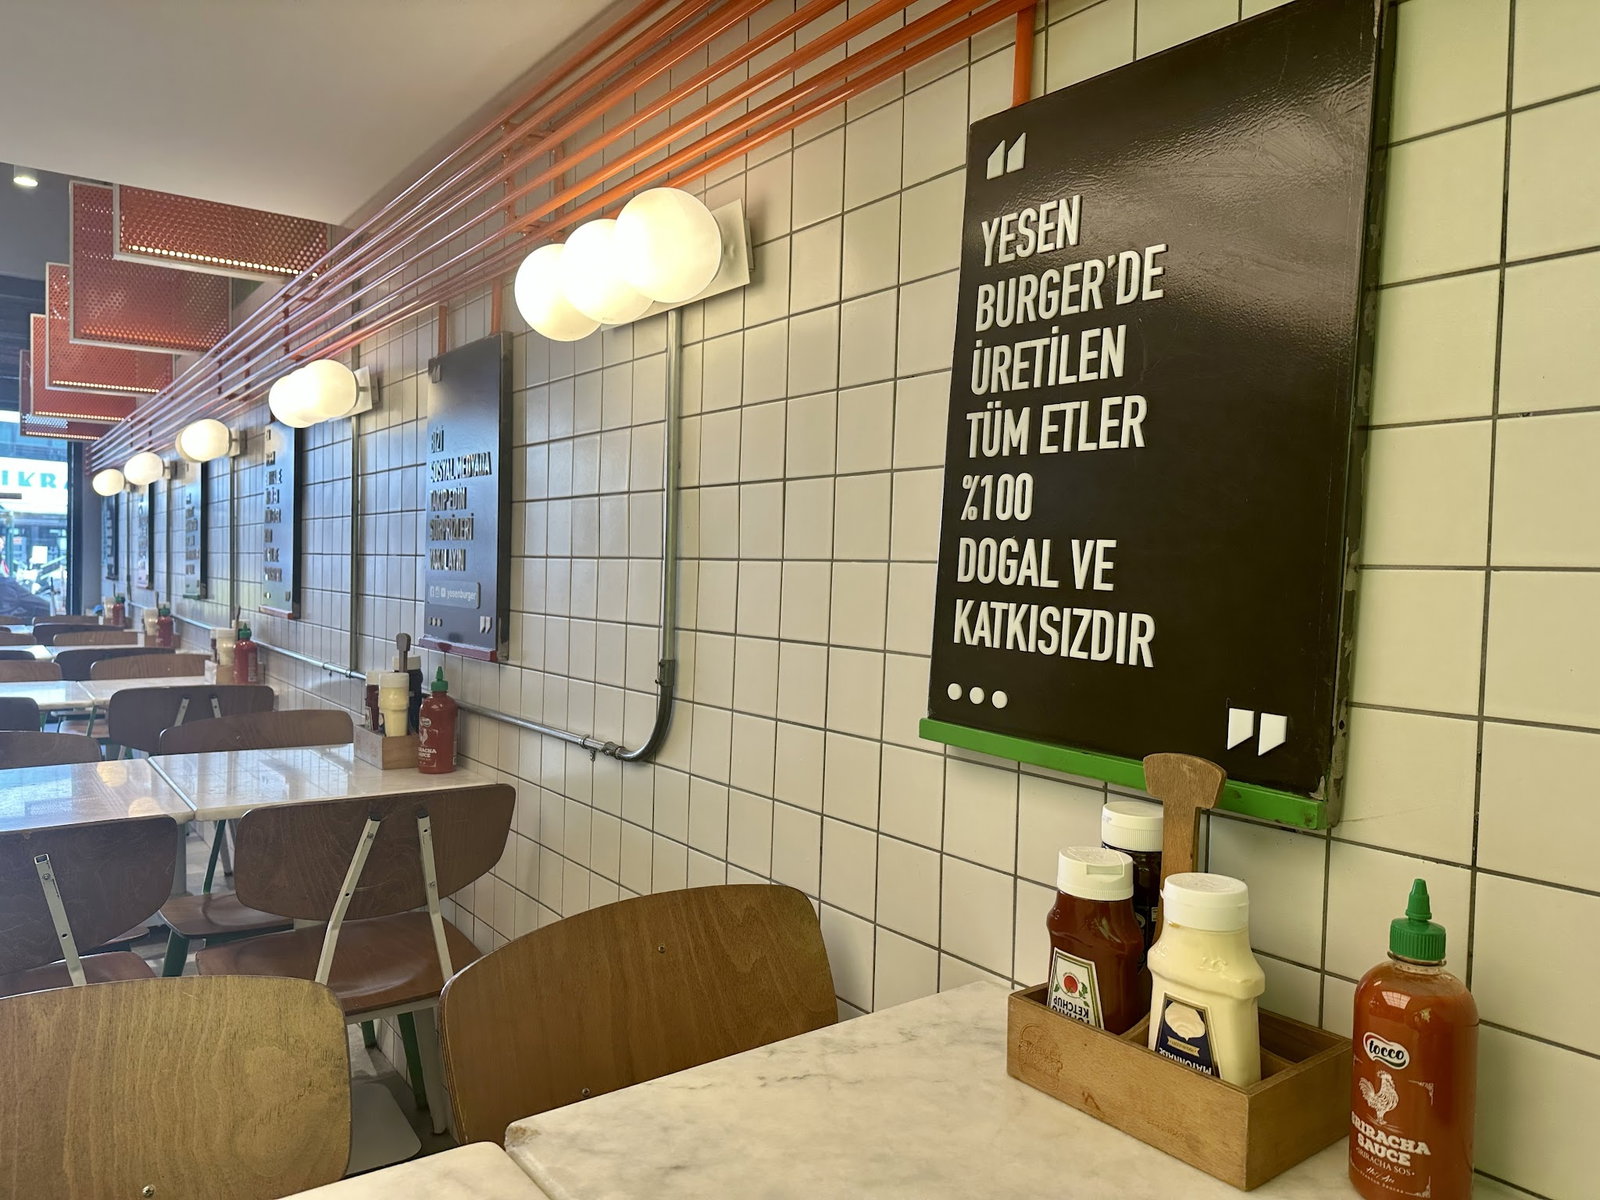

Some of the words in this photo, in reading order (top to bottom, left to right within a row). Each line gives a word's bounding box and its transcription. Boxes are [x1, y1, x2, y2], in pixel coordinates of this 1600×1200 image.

[981, 194, 1081, 267] YESEN
[975, 243, 1167, 332] BURGER'DE
[966, 400, 1031, 459] TÜM
[1039, 394, 1148, 455] ETLER
[960, 472, 1035, 521] %100
[1071, 539, 1117, 591] VE
[953, 598, 1155, 668] KATKISIZDIR
[1053, 996, 1089, 1019] KETCHUP
[1369, 1040, 1405, 1060] tocco
[1357, 1132, 1411, 1167] SAUCE
